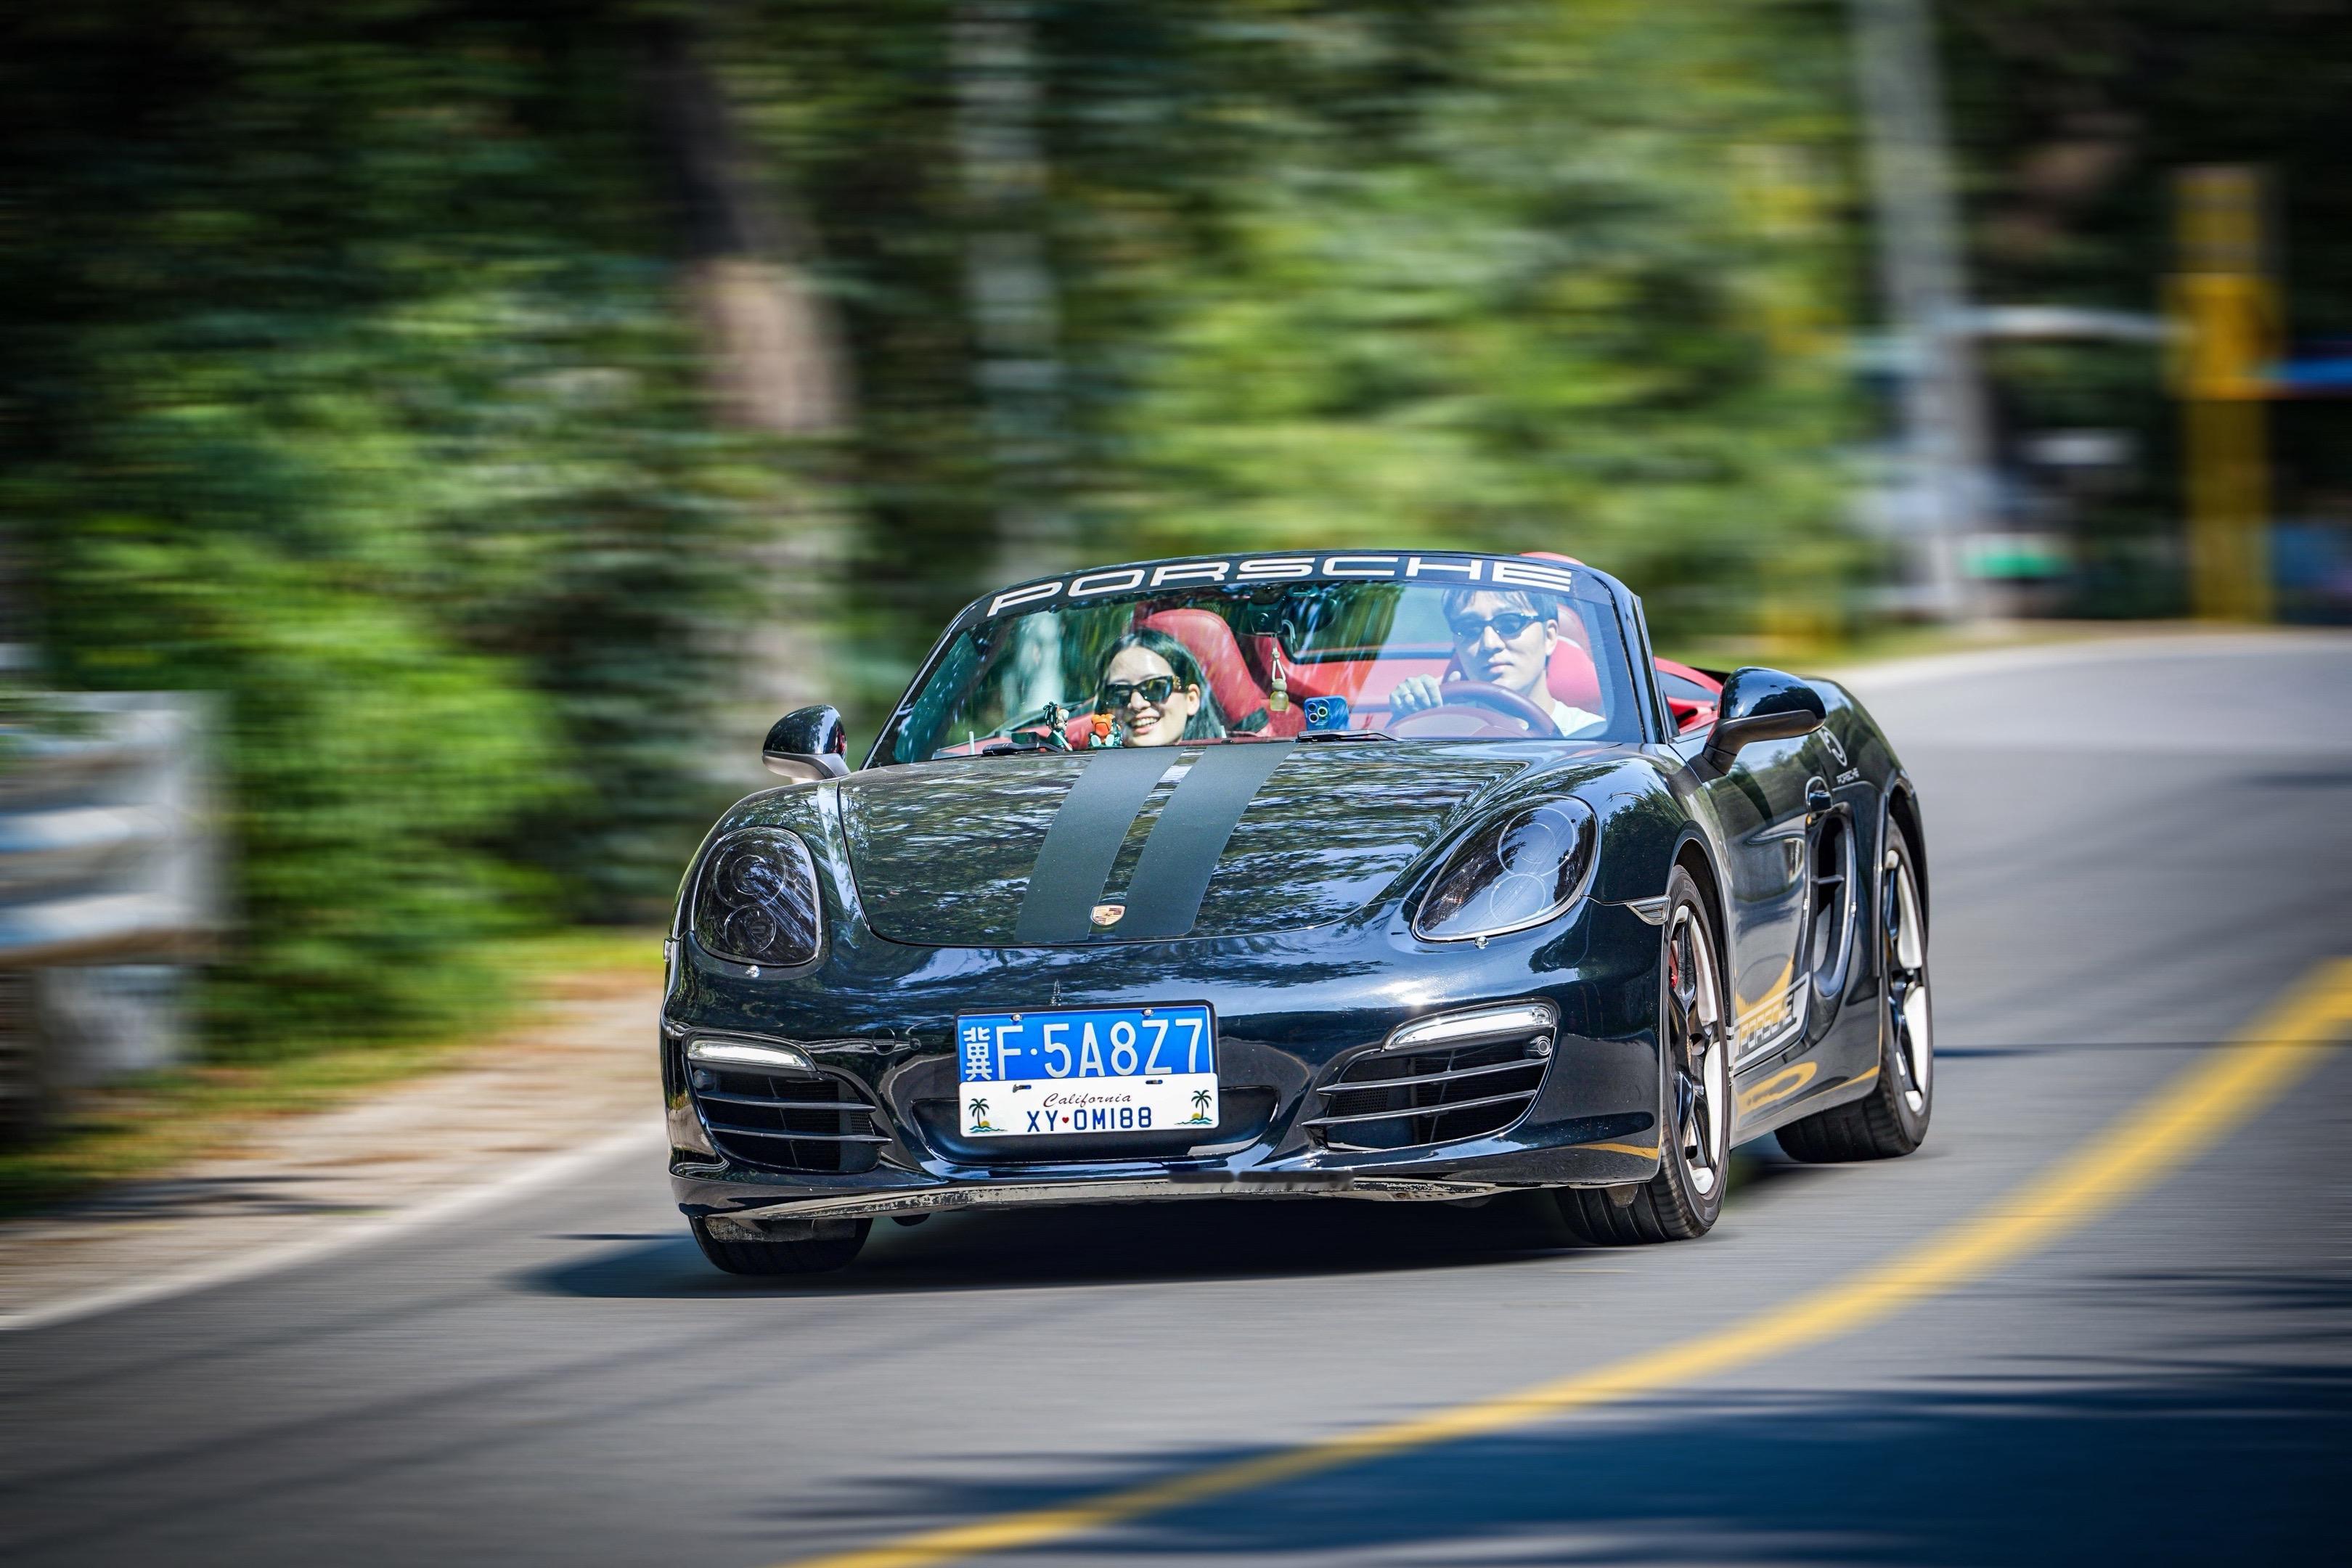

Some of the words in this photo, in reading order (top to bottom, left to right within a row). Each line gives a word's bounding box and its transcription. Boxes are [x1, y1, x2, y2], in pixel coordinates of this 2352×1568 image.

[987, 556, 1572, 617] PORSCHE
[1739, 992, 1793, 1055] PORSCHE
[1043, 1093, 1132, 1108] California
